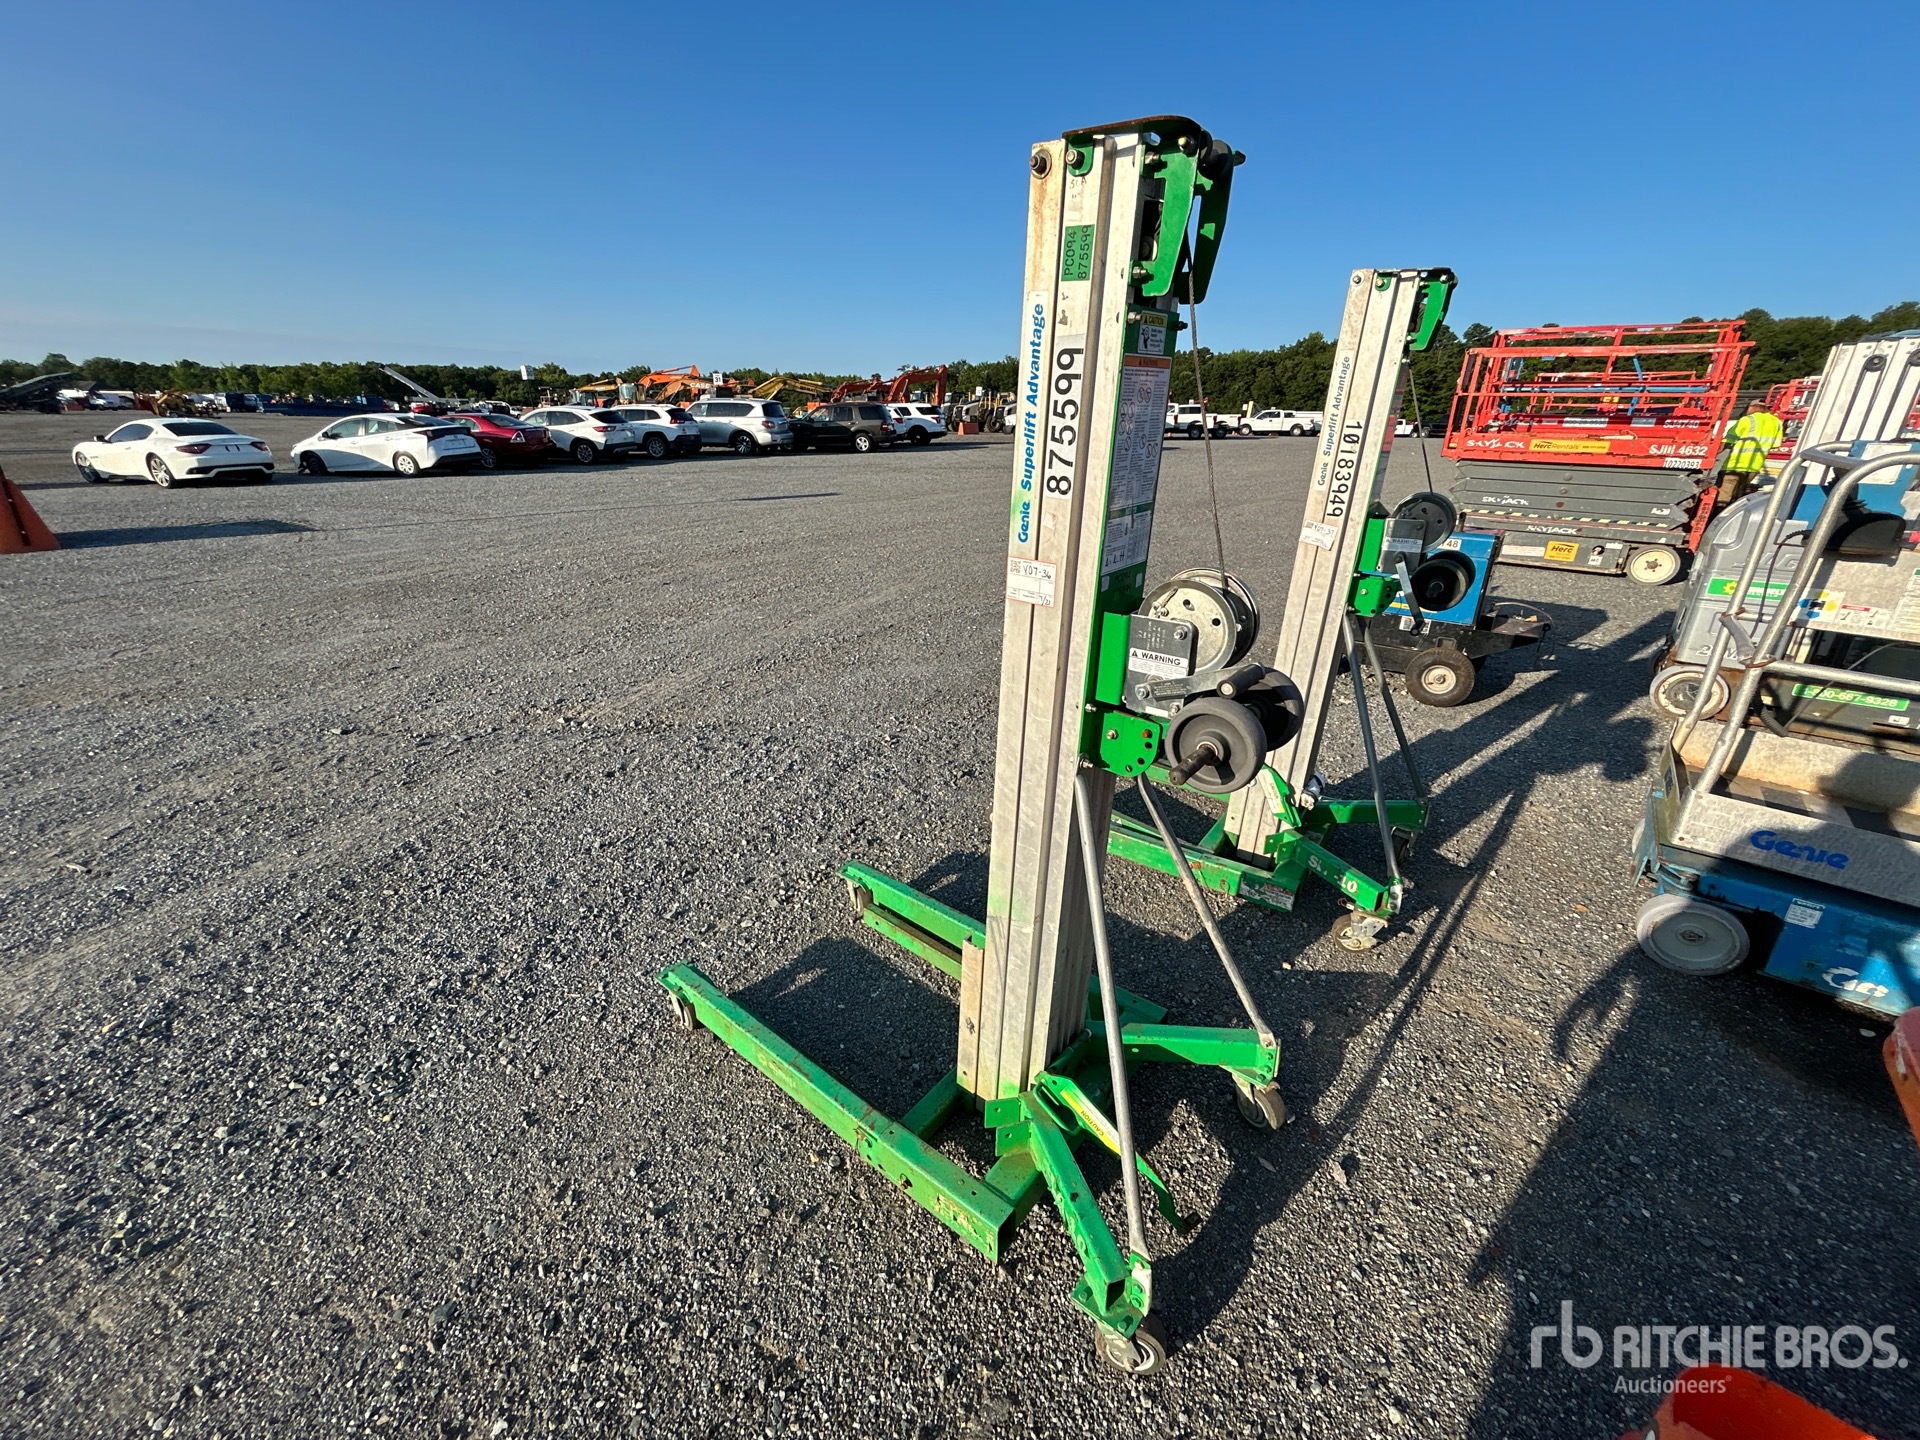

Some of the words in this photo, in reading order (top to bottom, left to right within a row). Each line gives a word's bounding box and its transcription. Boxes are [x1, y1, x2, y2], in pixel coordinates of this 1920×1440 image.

[1064, 230, 1077, 276] PC094
[1077, 225, 1091, 280] 875599
[1026, 303, 1044, 407] Advantage
[1046, 347, 1085, 495] 875599
[1317, 462, 1329, 486] Genie
[1323, 413, 1339, 457] Superlift
[1331, 356, 1350, 411] Advantage
[1020, 411, 1037, 491] Superlift
[1466, 438, 1525, 449] SKYJCK
[1678, 445, 1708, 456] 4632
[1326, 420, 1363, 518] 10183949
[1482, 495, 1529, 506] SKJACK
[1018, 501, 1031, 544] Genie
[1526, 525, 1578, 535] SKYJACK
[1550, 545, 1574, 554] Herc
[1141, 651, 1181, 666] WARNING
[1750, 830, 1849, 871] Genie
[1080, 1110, 1104, 1137] CAUTION
